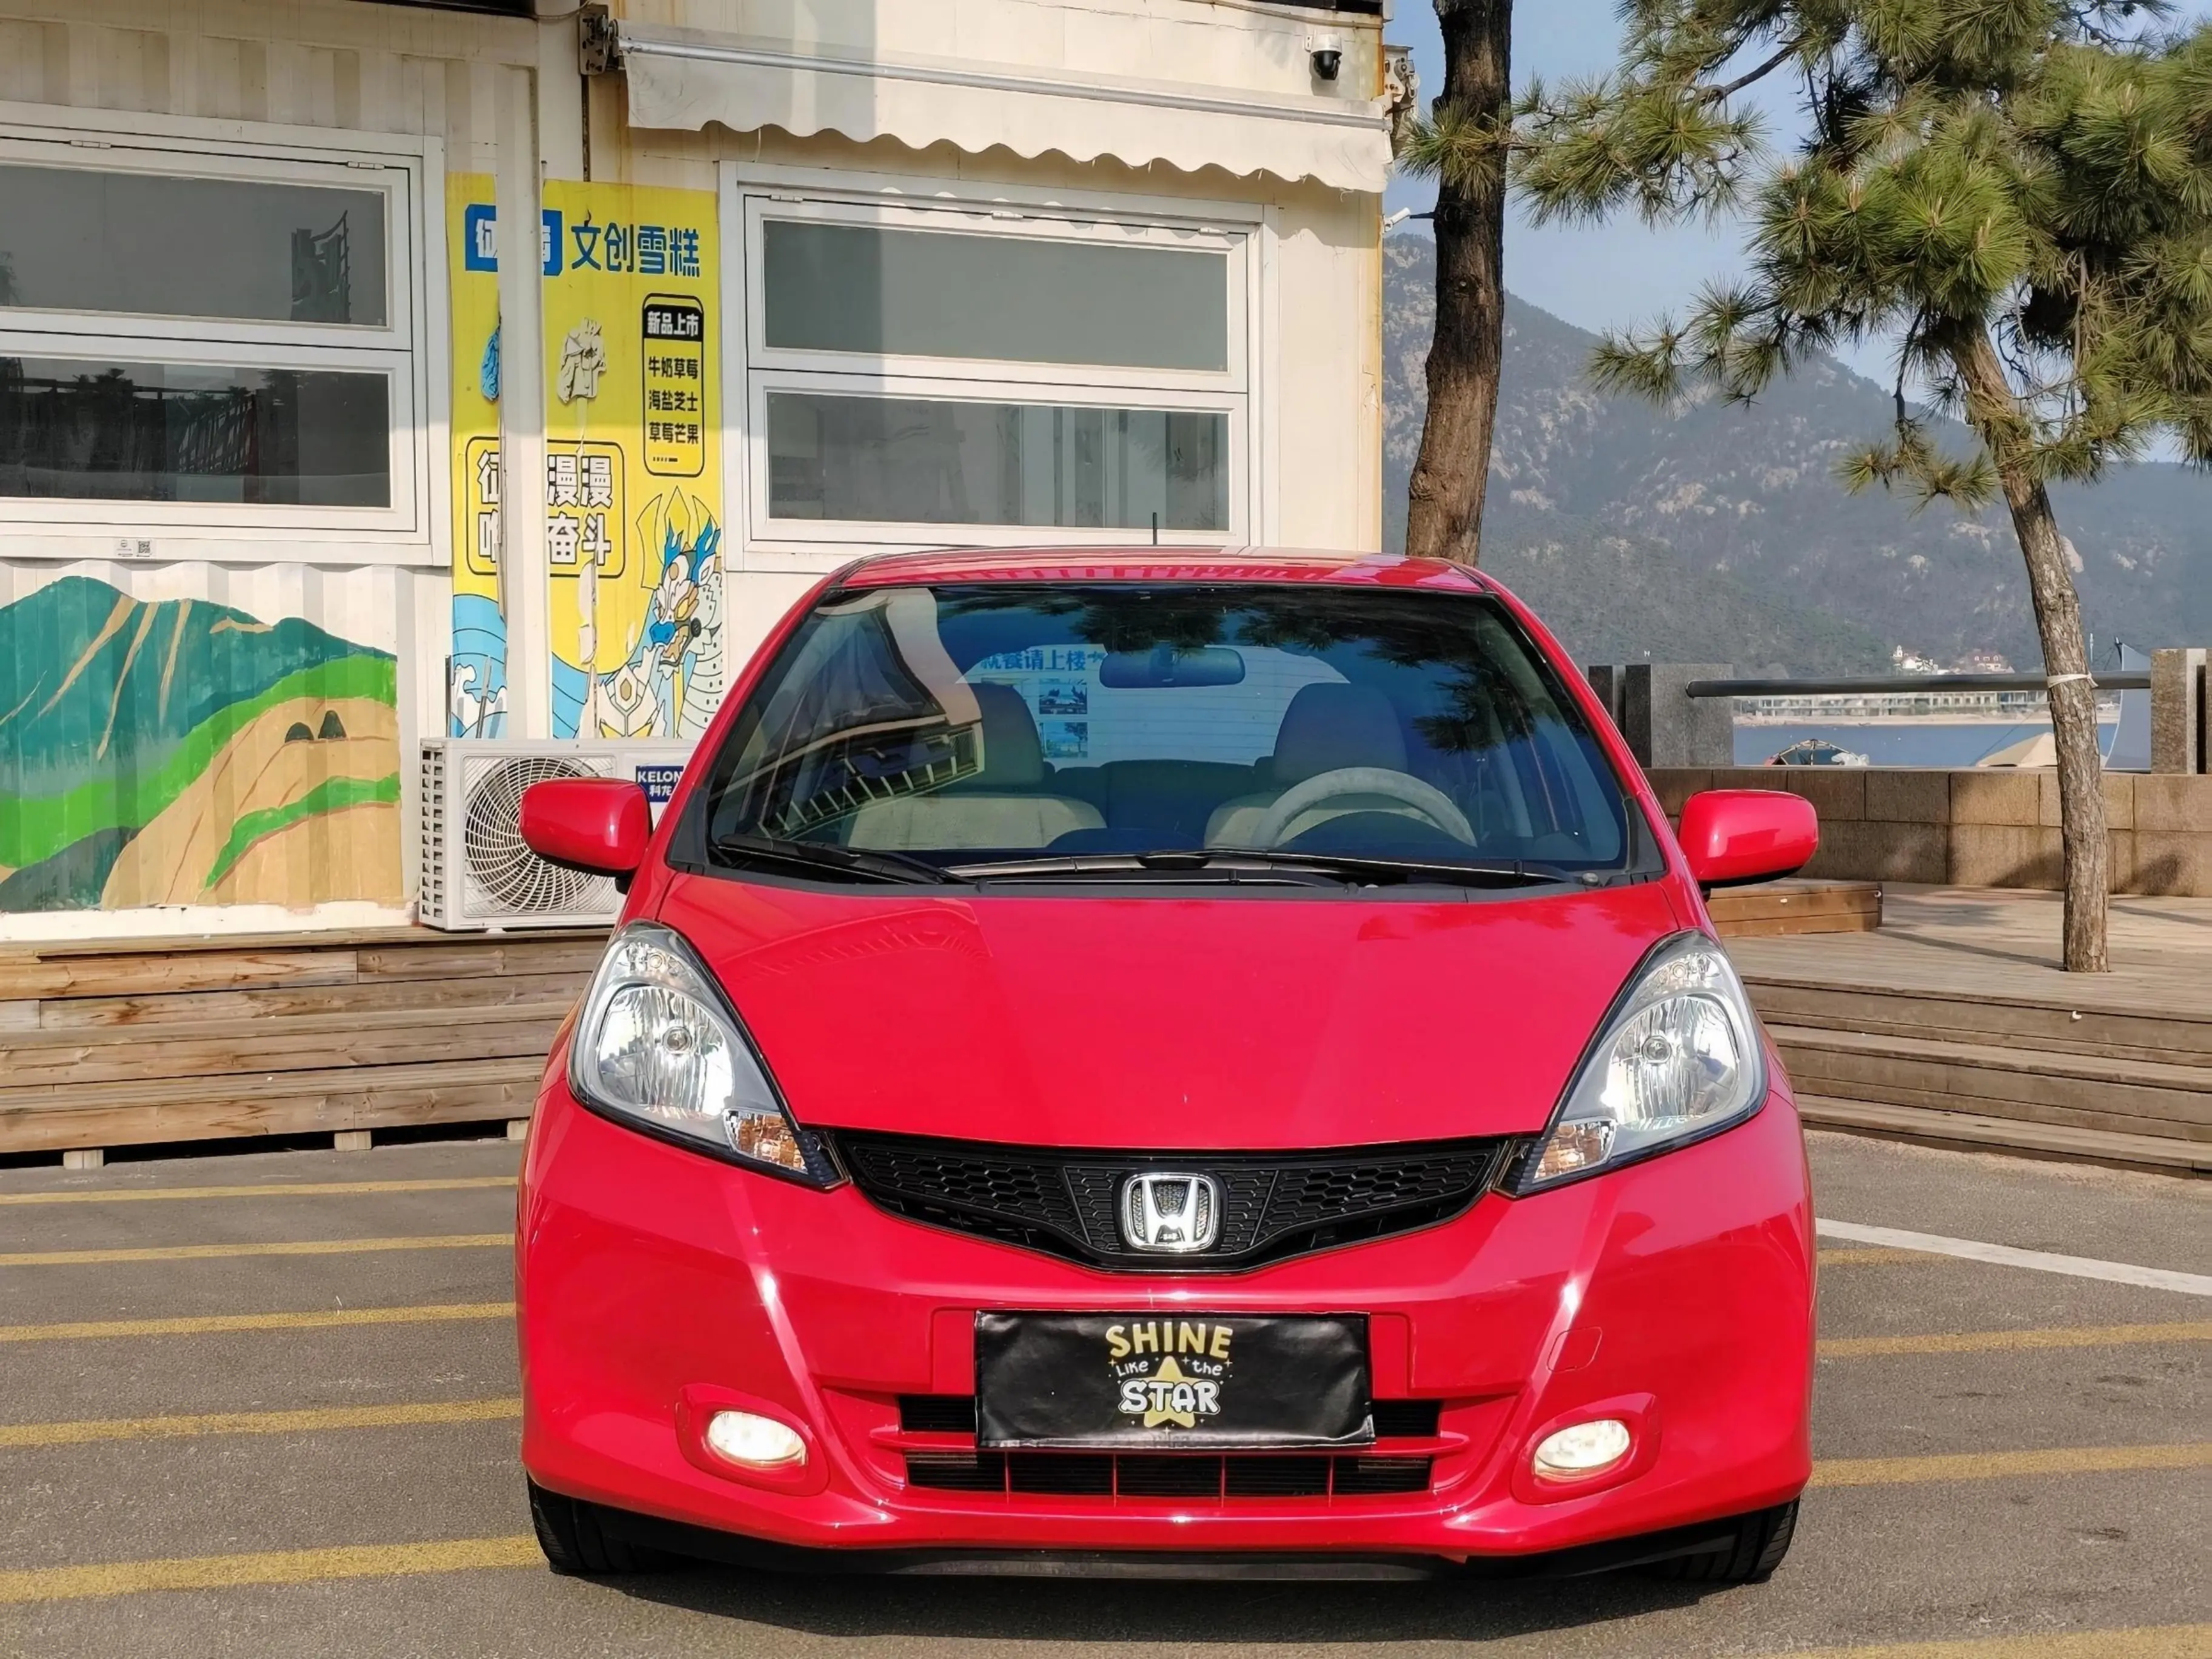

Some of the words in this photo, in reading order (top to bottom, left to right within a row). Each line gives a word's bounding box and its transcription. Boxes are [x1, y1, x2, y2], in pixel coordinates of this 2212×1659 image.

[571, 222, 700, 278] 文创雪糕
[647, 311, 699, 337] 新品上市
[648, 356, 699, 380] 牛奶草莓
[648, 390, 698, 412] 海盐芝士
[649, 422, 699, 444] 草莓芒果
[637, 771, 682, 783] KELON
[649, 785, 672, 797] 科龙
[1105, 1321, 1233, 1359] SHINE
[1191, 1359, 1223, 1376] the
[1119, 1379, 1221, 1415] STAR
